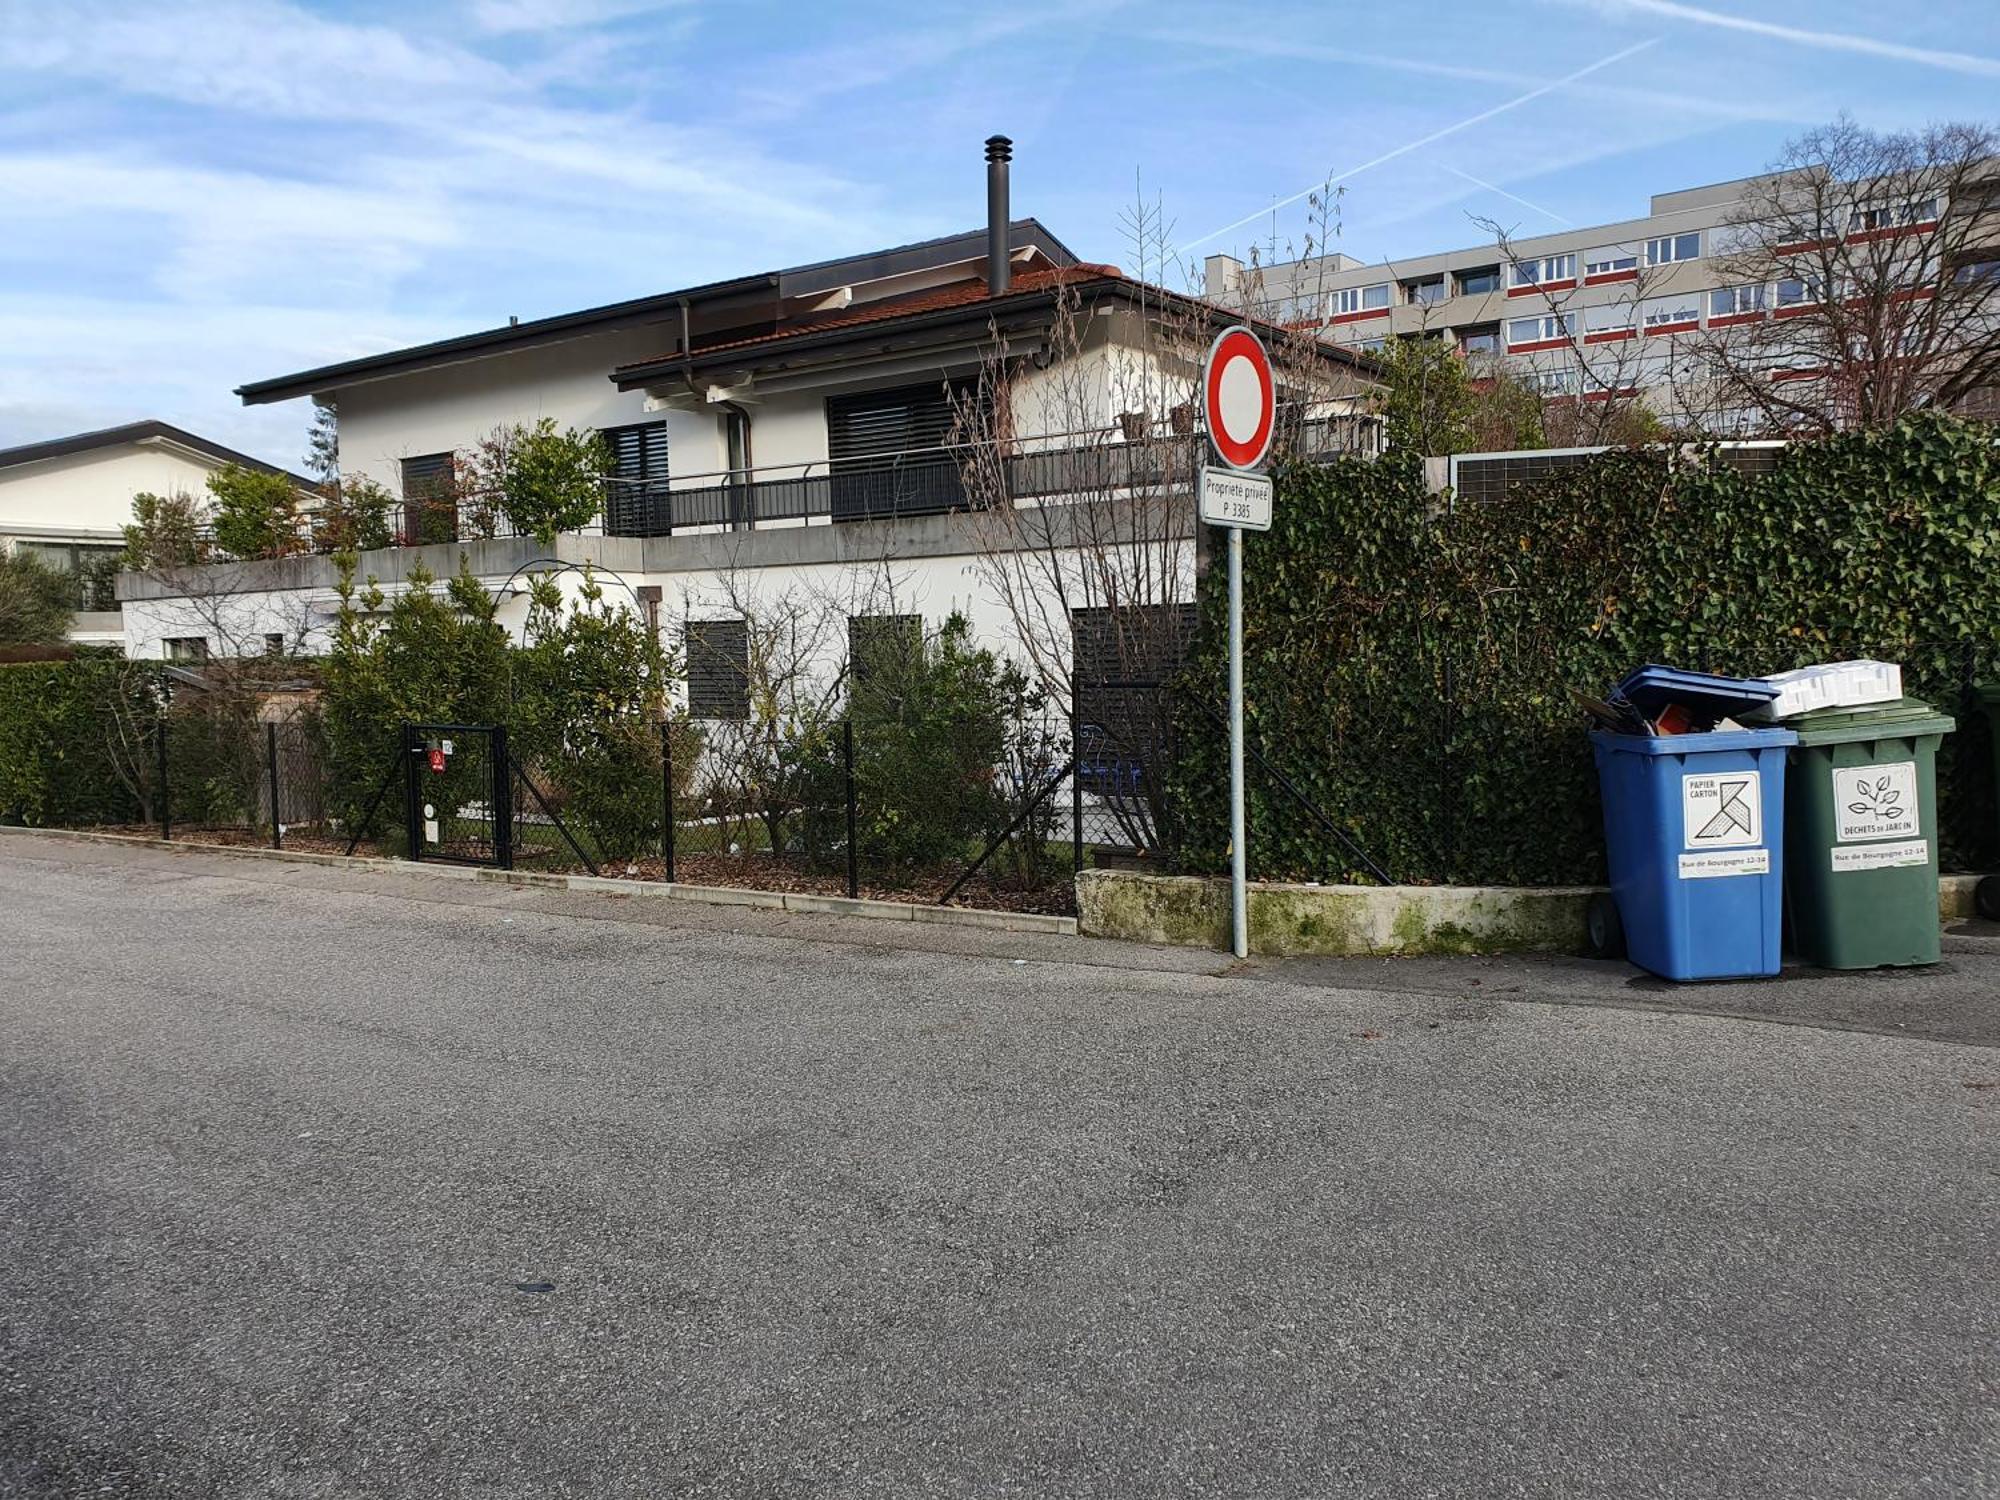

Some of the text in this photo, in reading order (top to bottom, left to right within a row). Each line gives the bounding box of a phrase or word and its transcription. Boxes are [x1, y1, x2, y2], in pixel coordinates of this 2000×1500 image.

[1244, 485, 1268, 501] privée
[1223, 502, 1250, 518] P 3385
[1690, 780, 1715, 790] PAPIER
[1690, 789, 1718, 798] CARTON
[1885, 821, 1912, 832] JARDIN
[1862, 851, 1902, 859] Bourgogne
